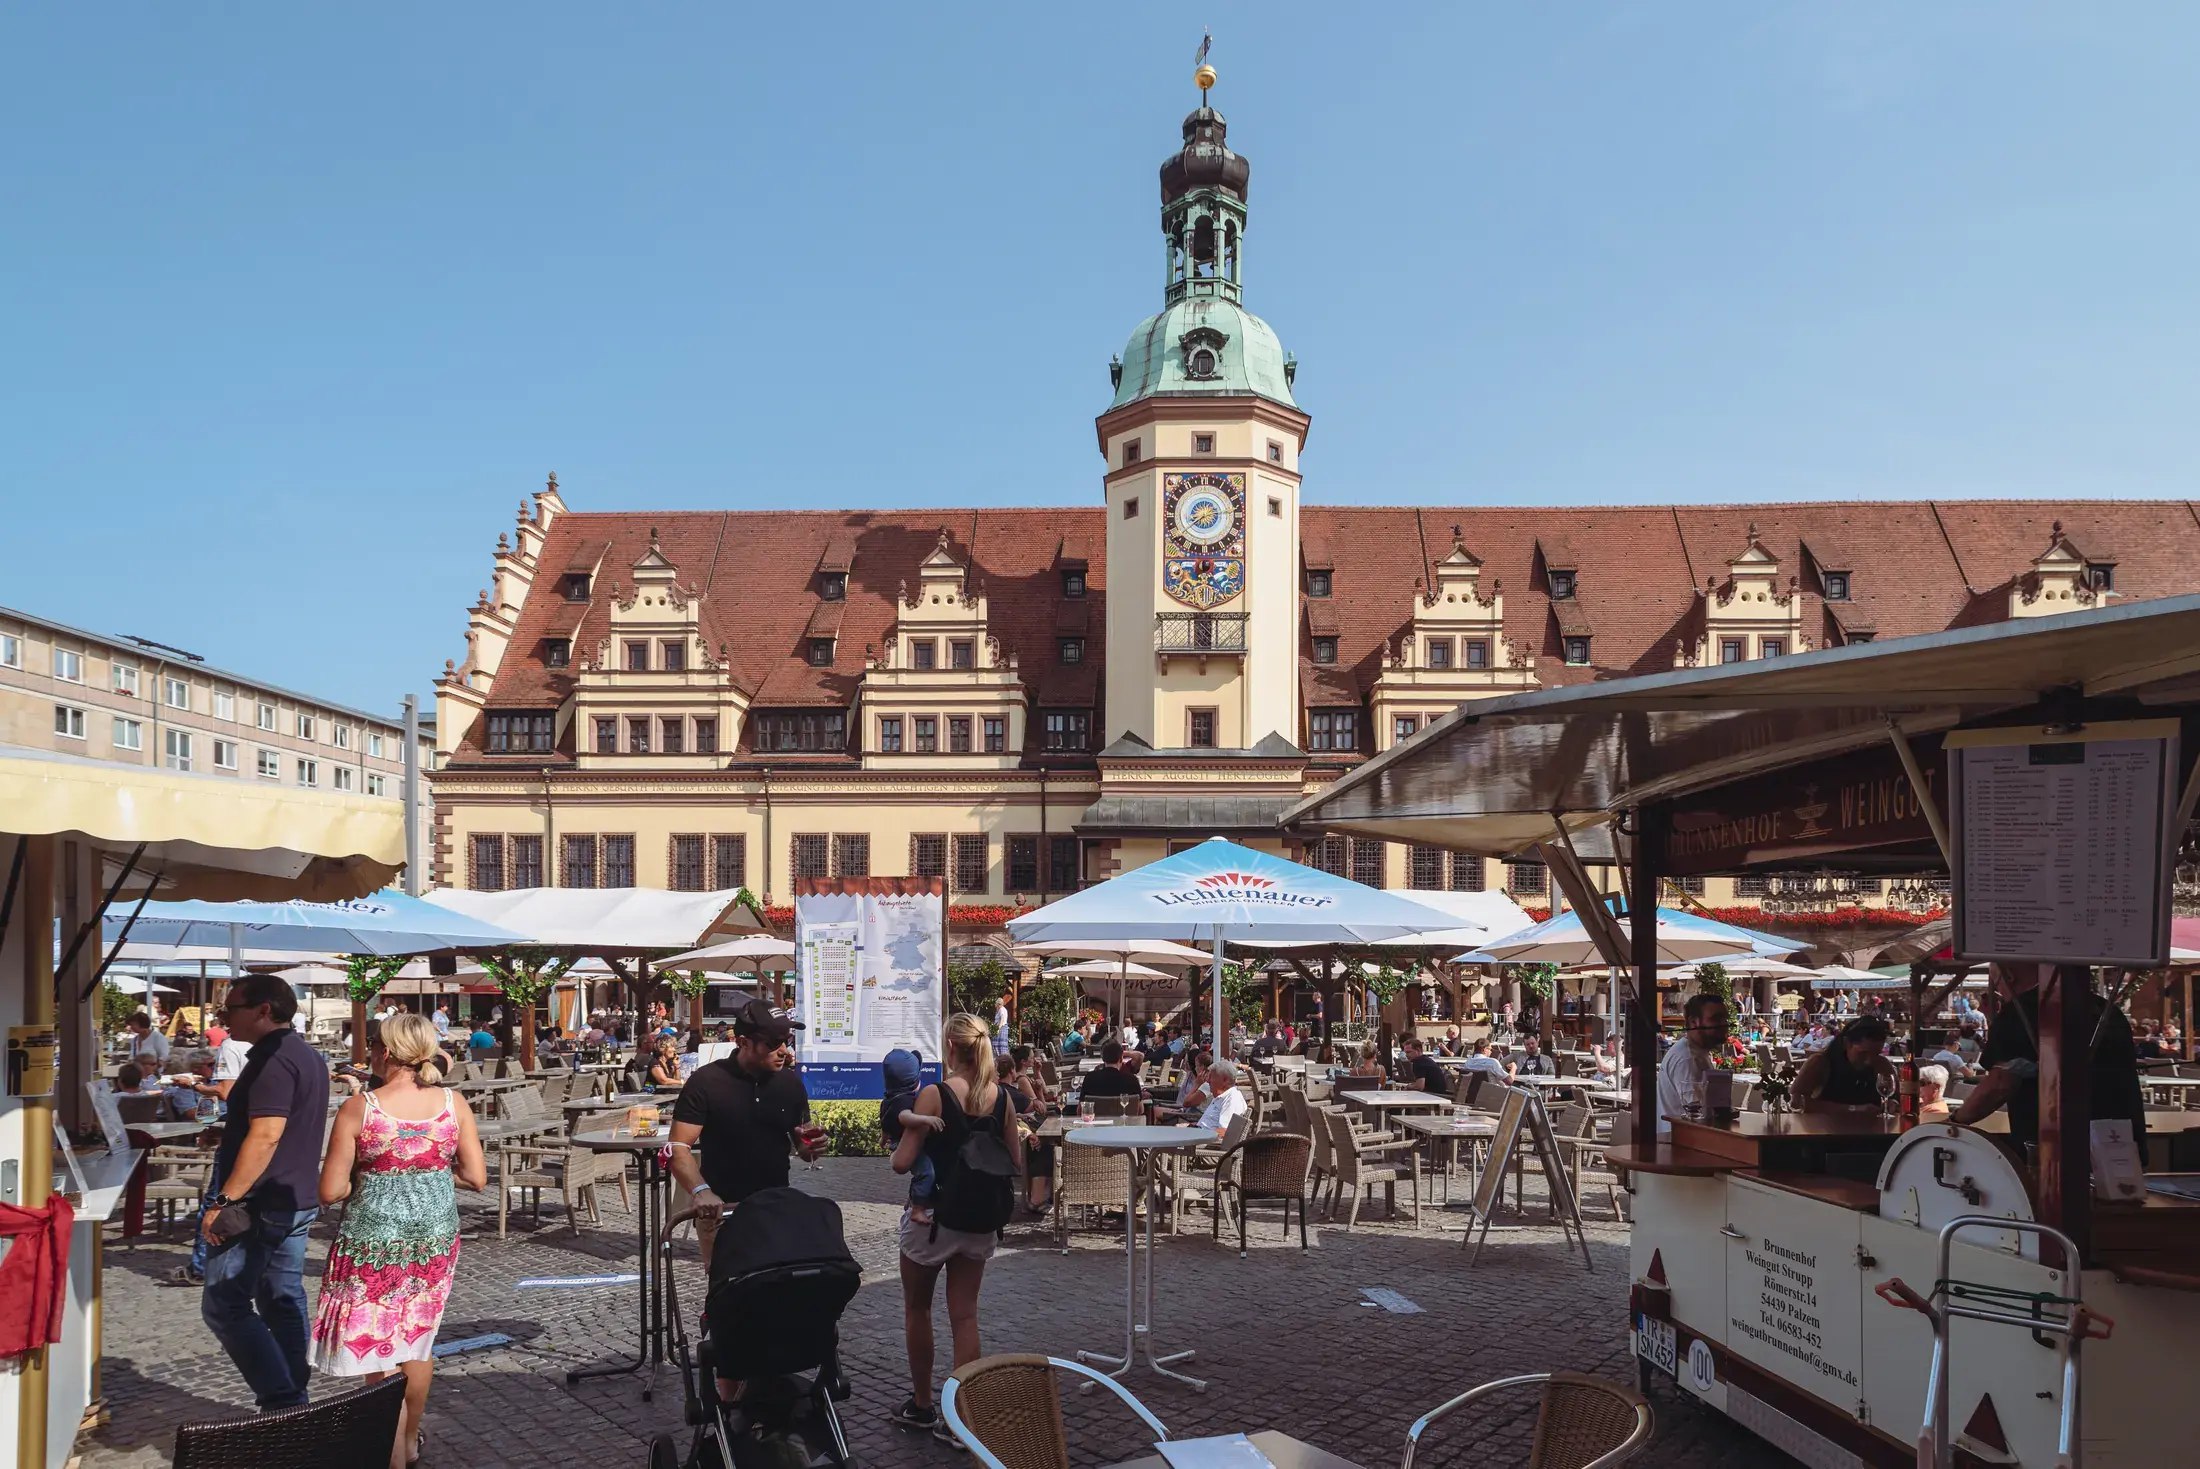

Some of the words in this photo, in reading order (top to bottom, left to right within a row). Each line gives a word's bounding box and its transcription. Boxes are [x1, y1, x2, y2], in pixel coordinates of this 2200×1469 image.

[1152, 888, 1332, 909] Lichtenauer
[1745, 1249, 1781, 1275] Weingut
[1781, 1259, 1813, 1288] Strupp
[1763, 1238, 1817, 1269] Brunnenhof
[1763, 1275, 1817, 1308] Römerstr.14
[1646, 1317, 1658, 1341] TR
[1760, 1292, 1786, 1313] 54439
[1788, 1303, 1821, 1329] Palzem
[1760, 1309, 1775, 1328] Tel.
[1776, 1317, 1822, 1349] 06583-452
[1640, 1334, 1654, 1358] SN
[1654, 1343, 1674, 1371] 452
[1691, 1345, 1712, 1385] 100
[1731, 1316, 1858, 1387] weingutbrunnenhof@gmx.de
